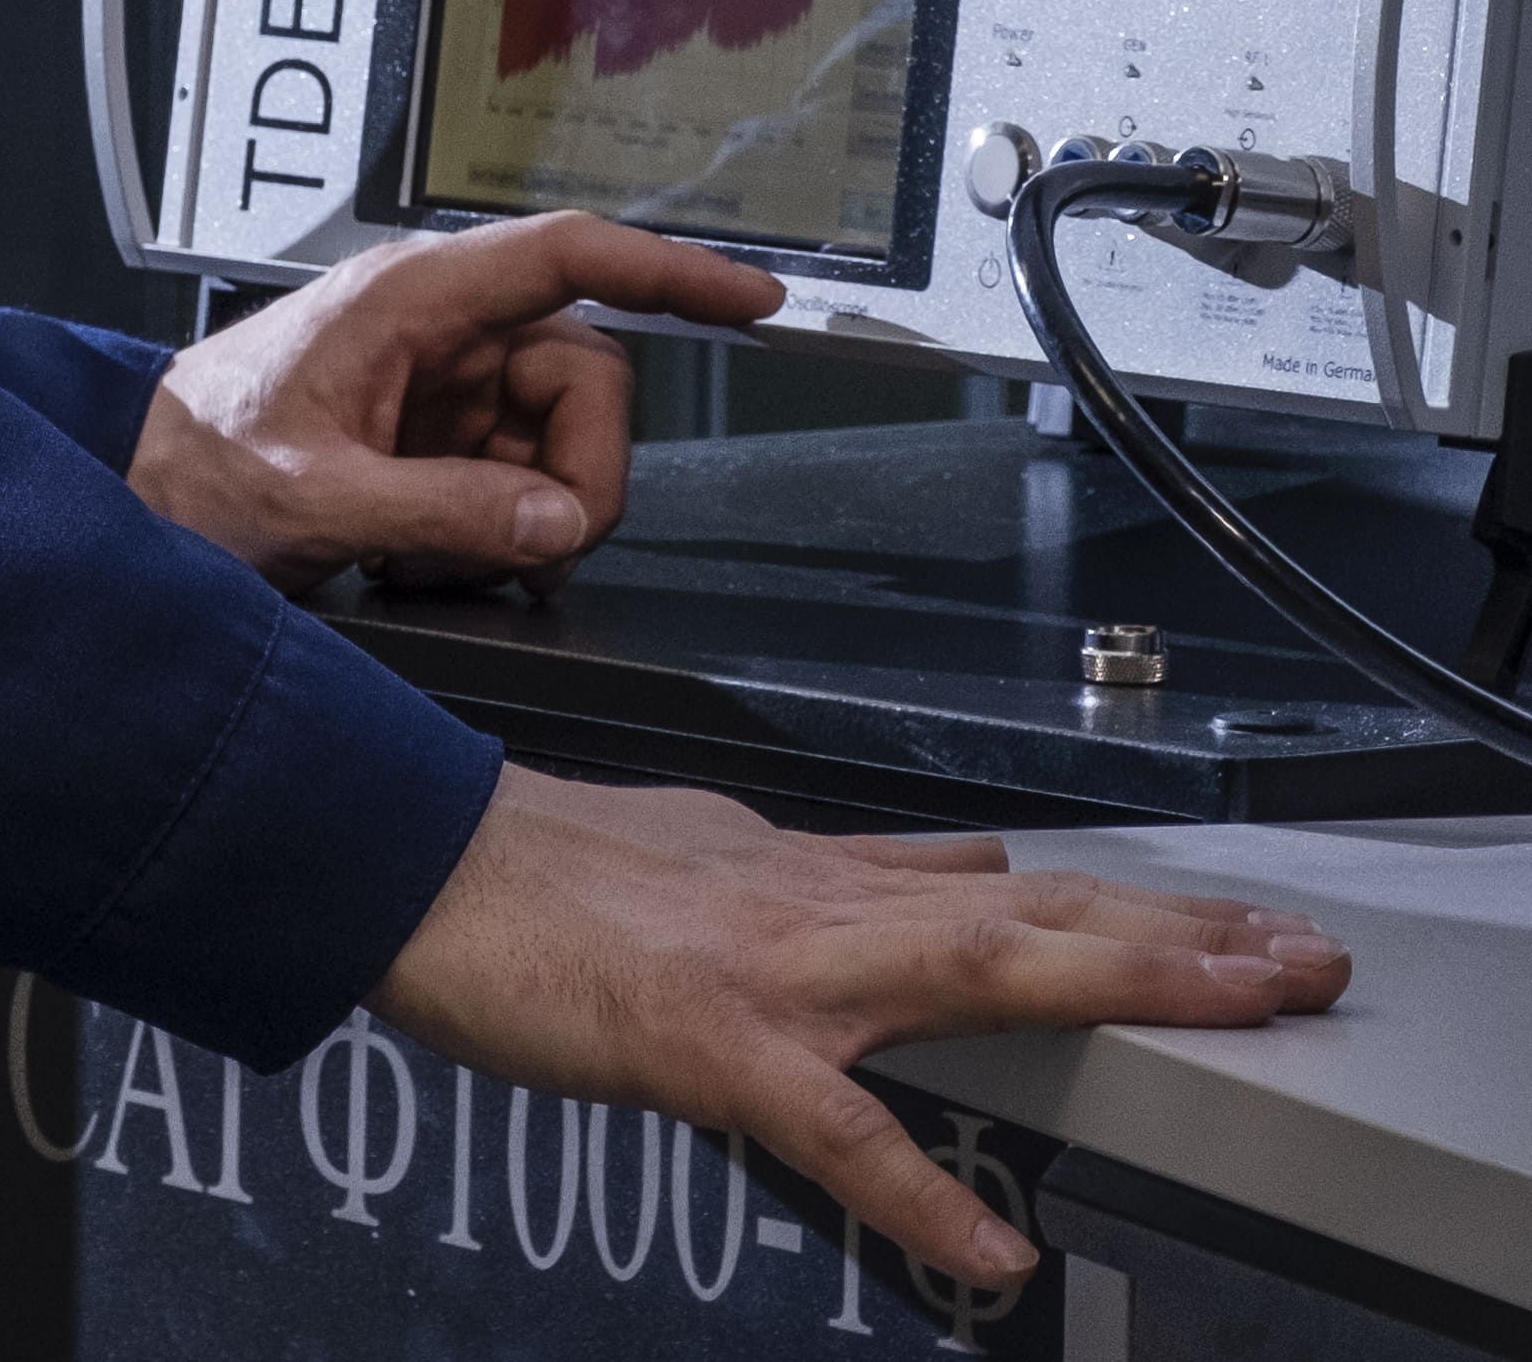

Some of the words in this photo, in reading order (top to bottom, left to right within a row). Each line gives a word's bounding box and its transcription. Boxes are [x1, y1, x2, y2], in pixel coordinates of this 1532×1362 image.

[993, 23, 1035, 43] Power
[1262, 354, 1300, 373] Made
[1305, 359, 1318, 375] in
[1324, 361, 1377, 382] Germa
